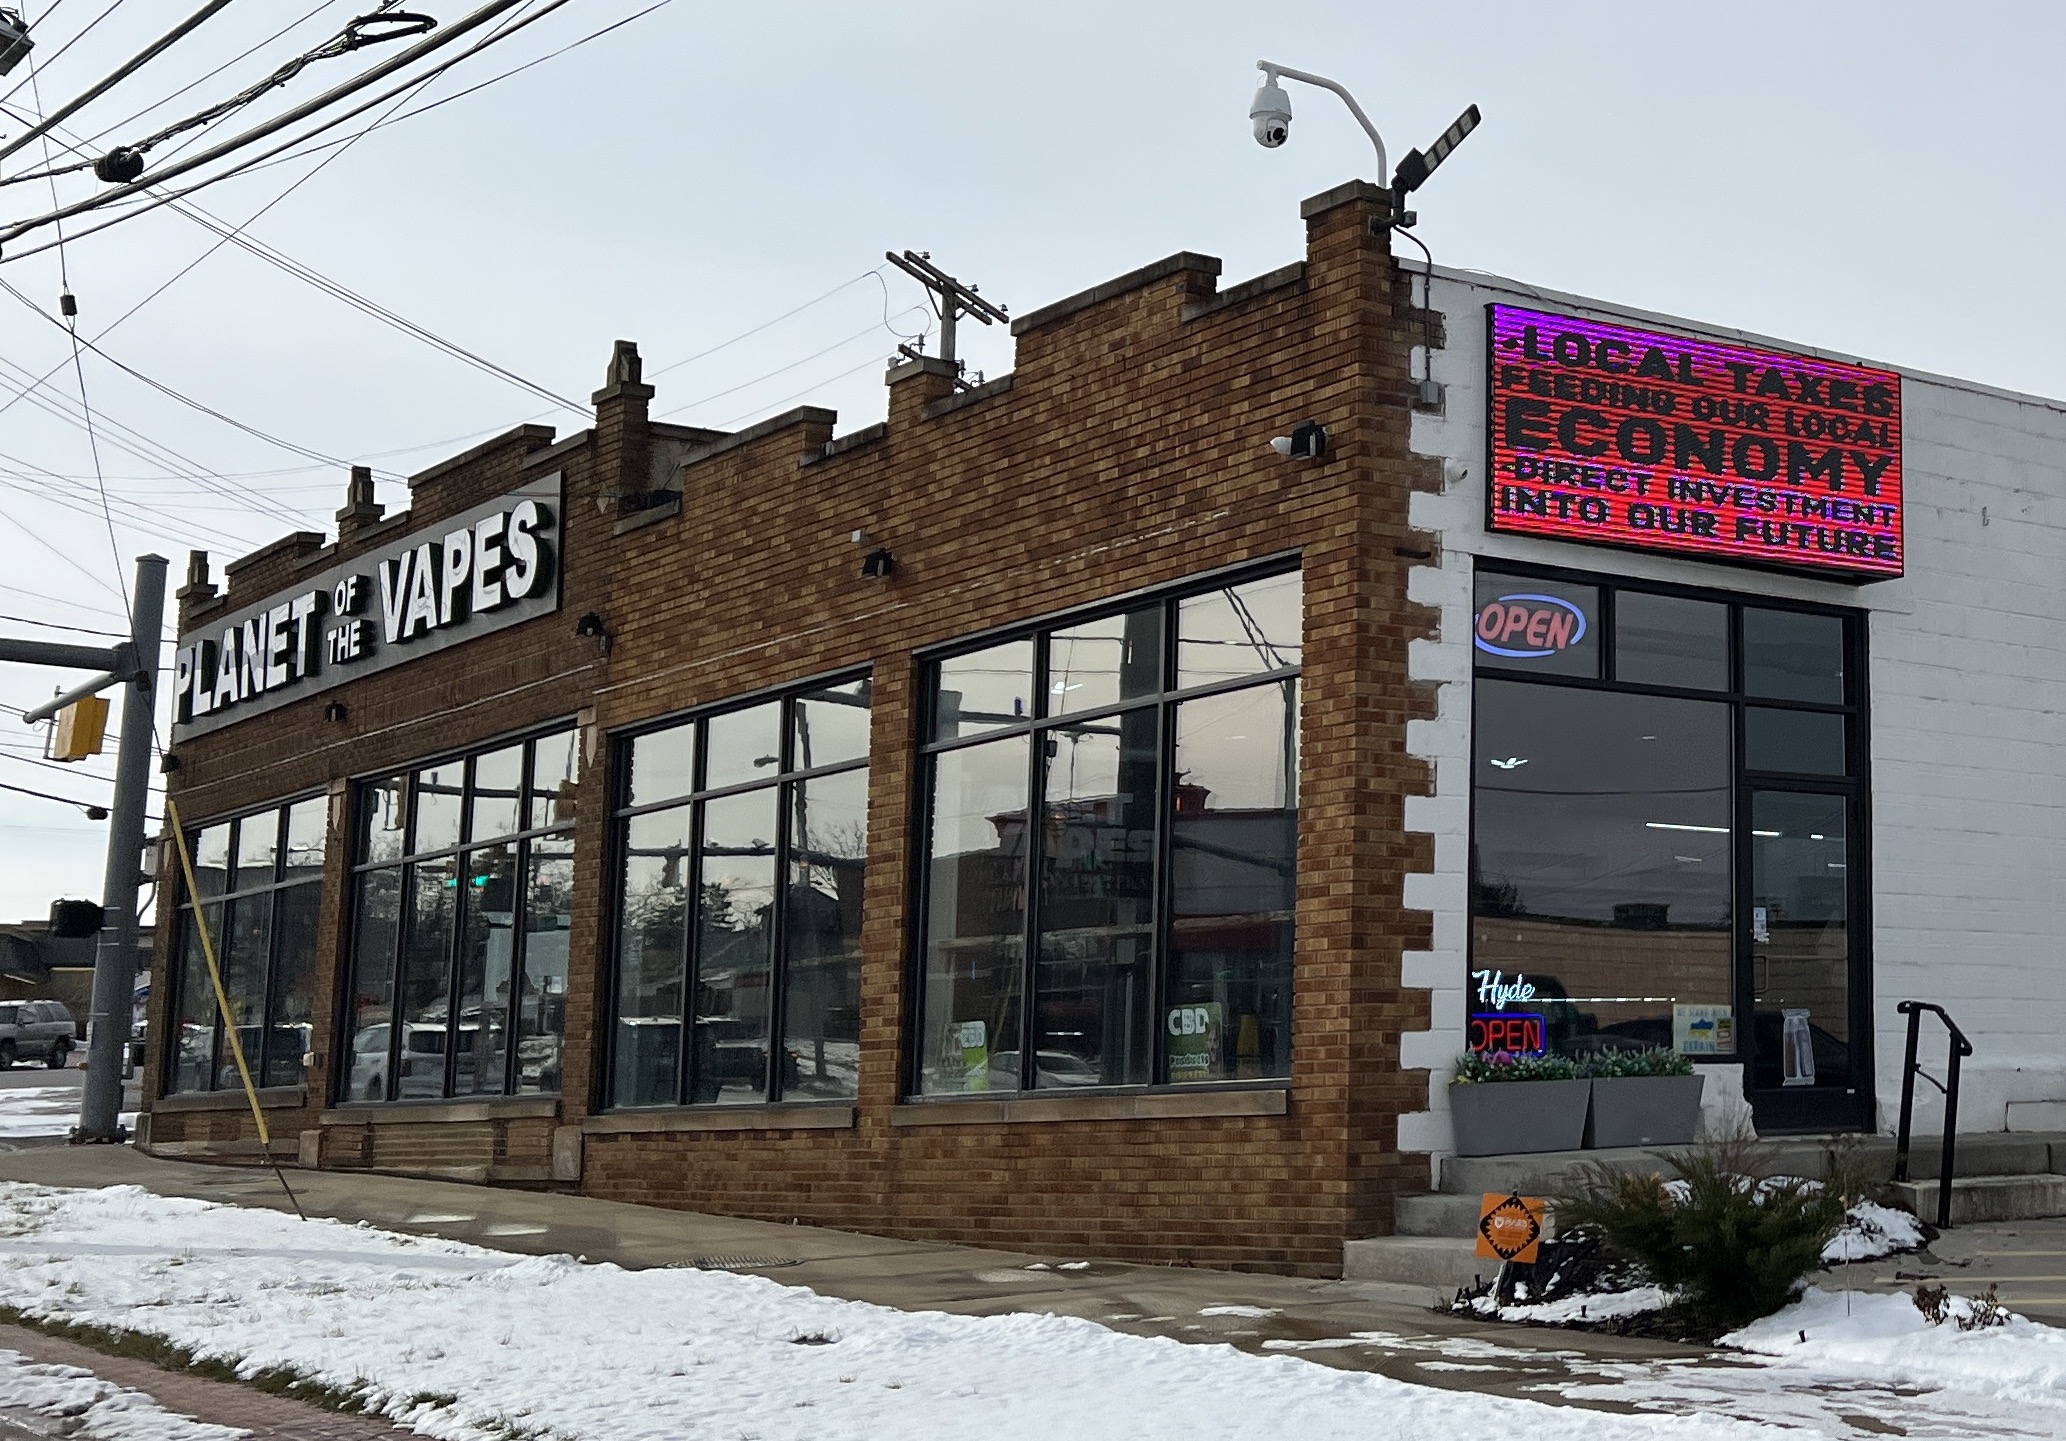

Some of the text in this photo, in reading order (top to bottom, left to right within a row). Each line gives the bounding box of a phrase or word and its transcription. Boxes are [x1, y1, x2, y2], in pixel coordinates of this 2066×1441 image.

[1501, 366, 1895, 448] FEEDING OUR LOCAL
[1726, 362, 1895, 417] TAXES
[1505, 398, 1893, 497] ECONOMY
[1502, 486, 1898, 560] INTO OUR FUTURE
[1668, 477, 1897, 528] INVESTMENT
[334, 574, 359, 617] OF
[378, 499, 540, 645] VAPES
[327, 620, 362, 666] THE
[1478, 602, 1574, 650] OPEN
[172, 590, 318, 724] PLANET
[1472, 969, 1536, 1011] Hyde
[1168, 1007, 1210, 1036] CBD
[1471, 1019, 1541, 1052] OPEN
